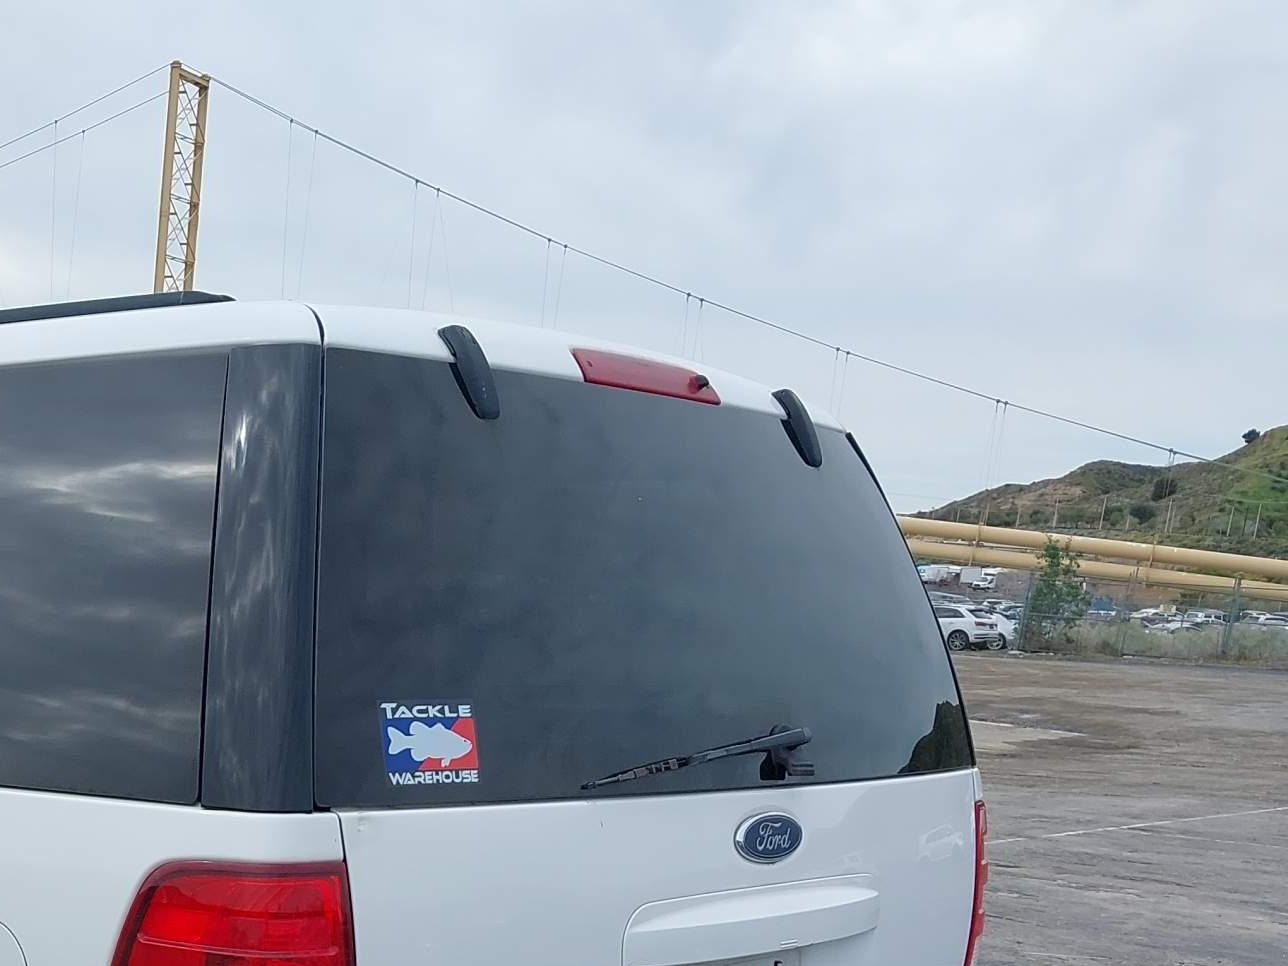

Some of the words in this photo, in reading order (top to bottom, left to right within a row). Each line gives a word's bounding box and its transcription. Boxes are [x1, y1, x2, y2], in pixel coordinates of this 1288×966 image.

[379, 702, 472, 719] TACKLE
[388, 769, 479, 785] WAREHOUSE
[756, 821, 792, 851] Ford
